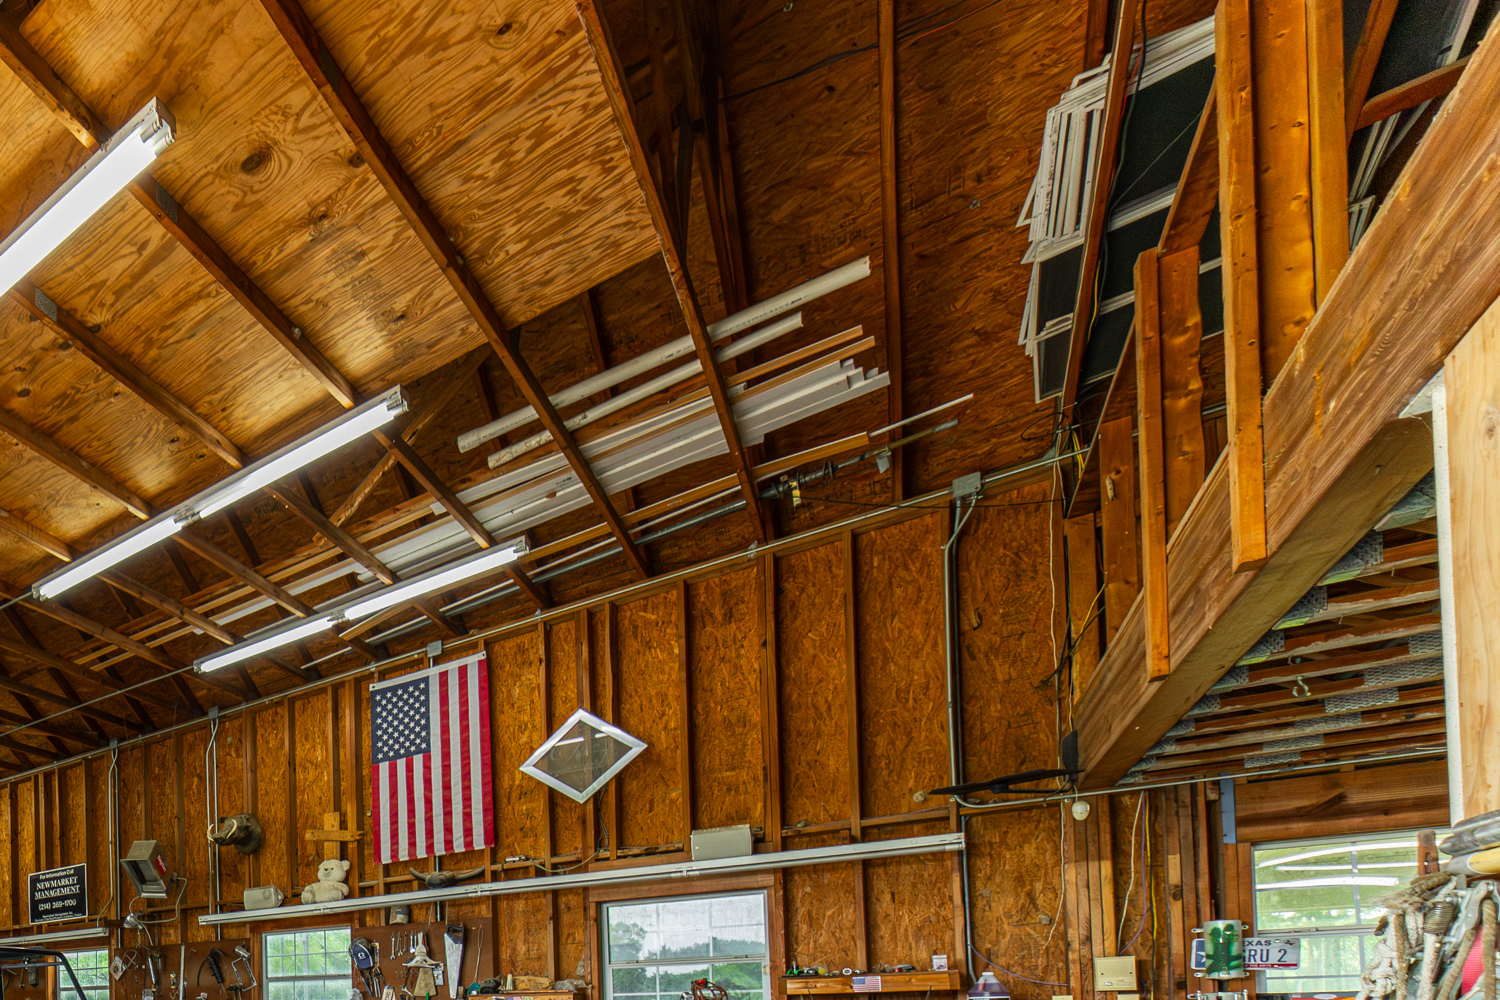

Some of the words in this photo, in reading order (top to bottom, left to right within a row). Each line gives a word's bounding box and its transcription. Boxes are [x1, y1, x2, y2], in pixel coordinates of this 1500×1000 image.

[36, 876, 78, 890] NEWMARKET
[35, 885, 80, 900] MANAGEMENT
[1243, 939, 1272, 947] EXAS
[1277, 948, 1287, 963] 2
